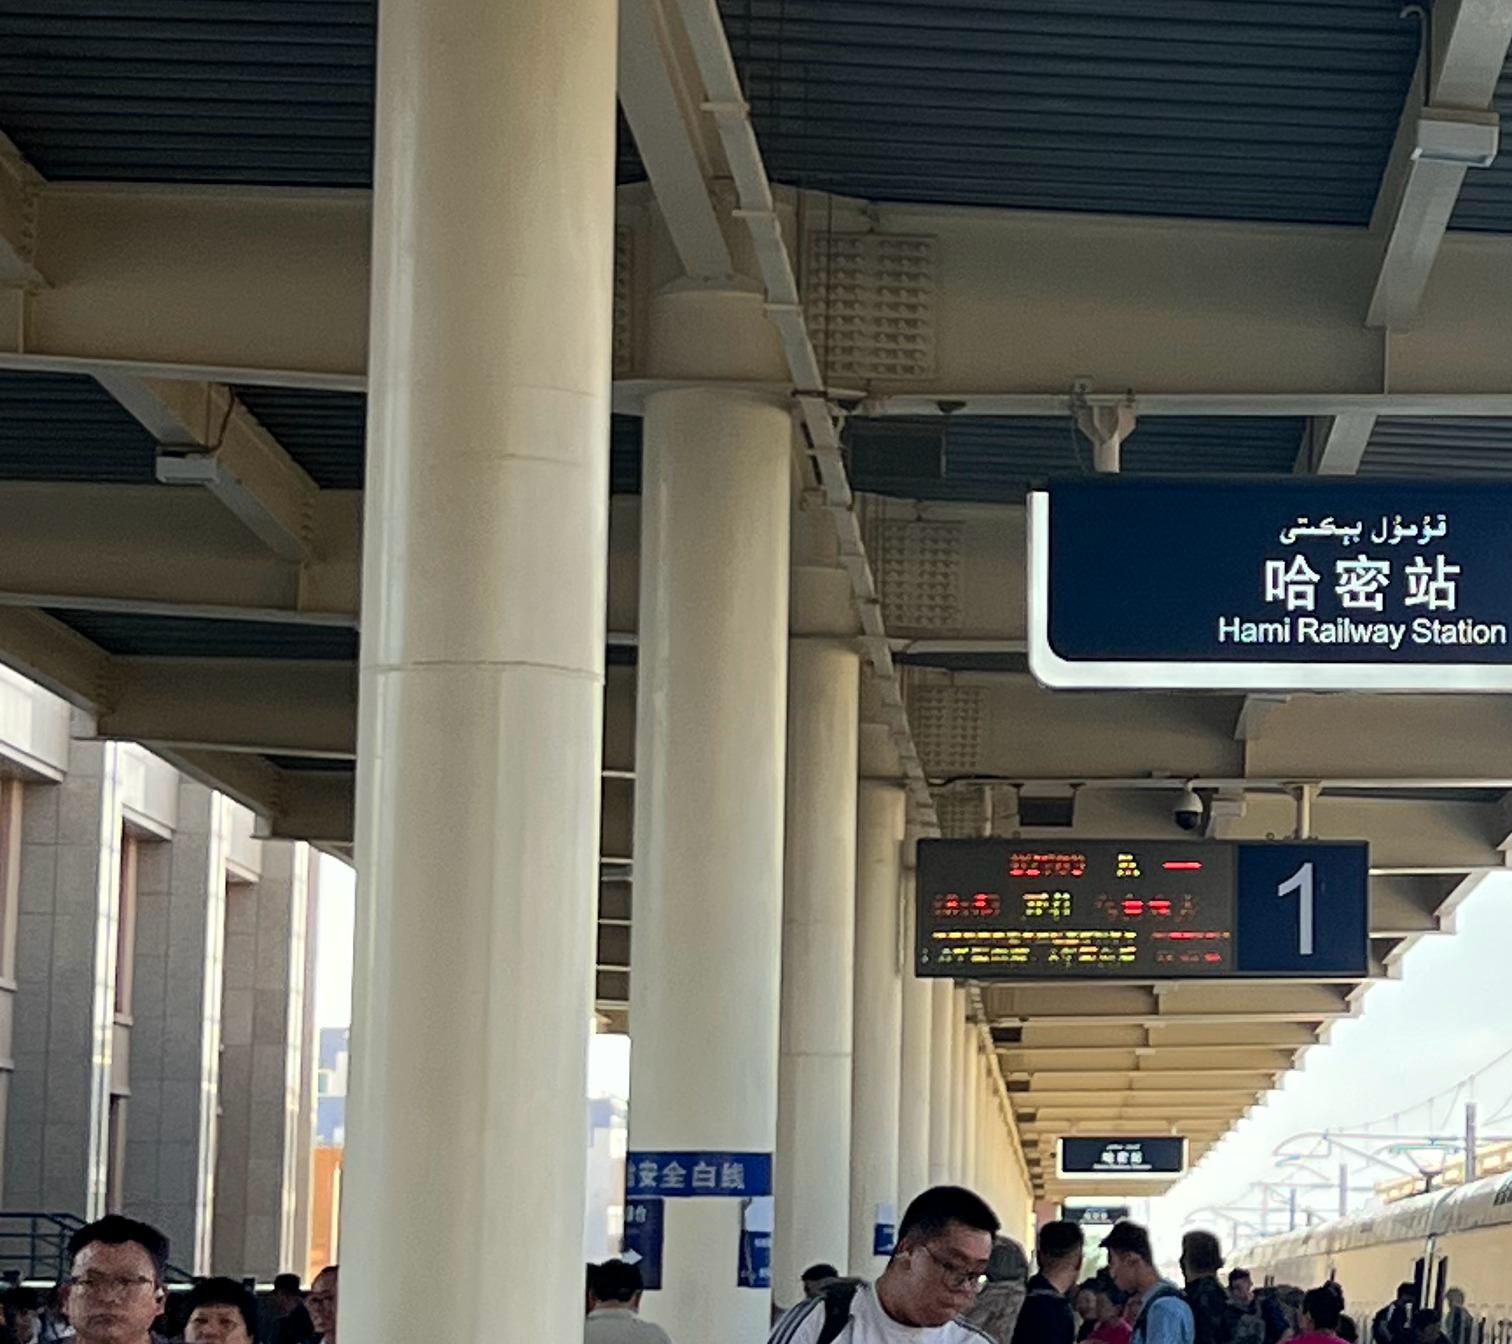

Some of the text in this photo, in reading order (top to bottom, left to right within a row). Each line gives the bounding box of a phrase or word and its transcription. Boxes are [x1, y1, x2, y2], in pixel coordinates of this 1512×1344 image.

[1264, 554, 1460, 611] 哈密站
[1217, 616, 1507, 651] Hami Railway Station
[1277, 862, 1314, 955] 1
